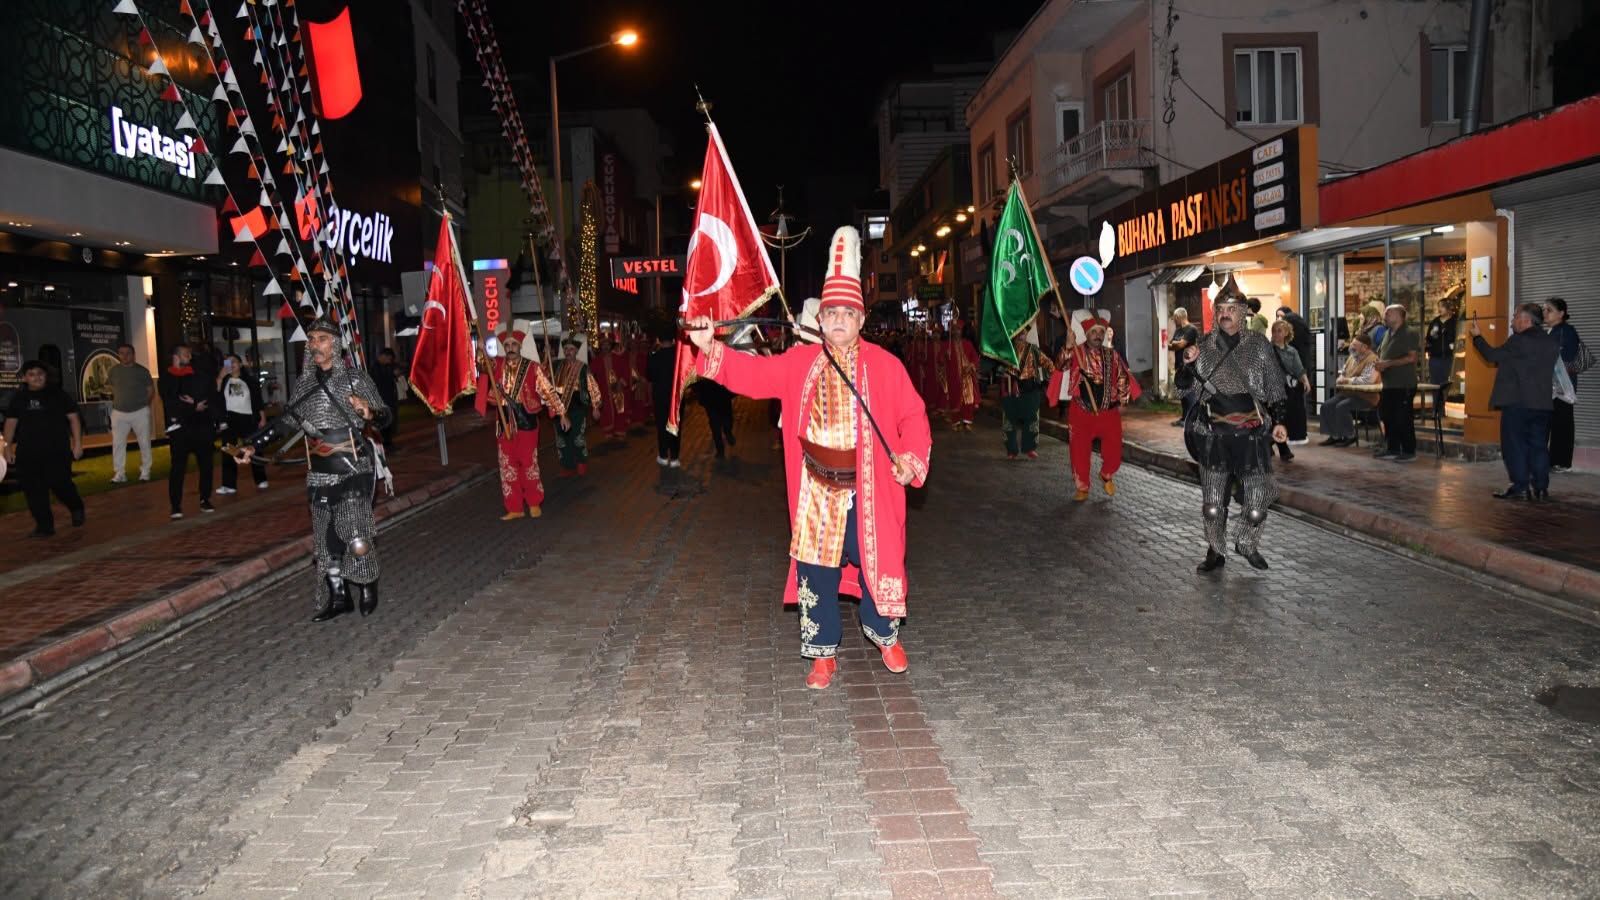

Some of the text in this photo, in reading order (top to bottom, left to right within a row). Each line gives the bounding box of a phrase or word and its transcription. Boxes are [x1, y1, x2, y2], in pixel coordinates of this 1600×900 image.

[1256, 144, 1279, 161] CAFE
[1117, 167, 1247, 257] BUHARA PASTANESİ
[1256, 189, 1281, 205] BAKLAVA
[326, 205, 393, 266] arçelik
[623, 259, 678, 274] VESTEL
[484, 276, 499, 331] BOSCH
